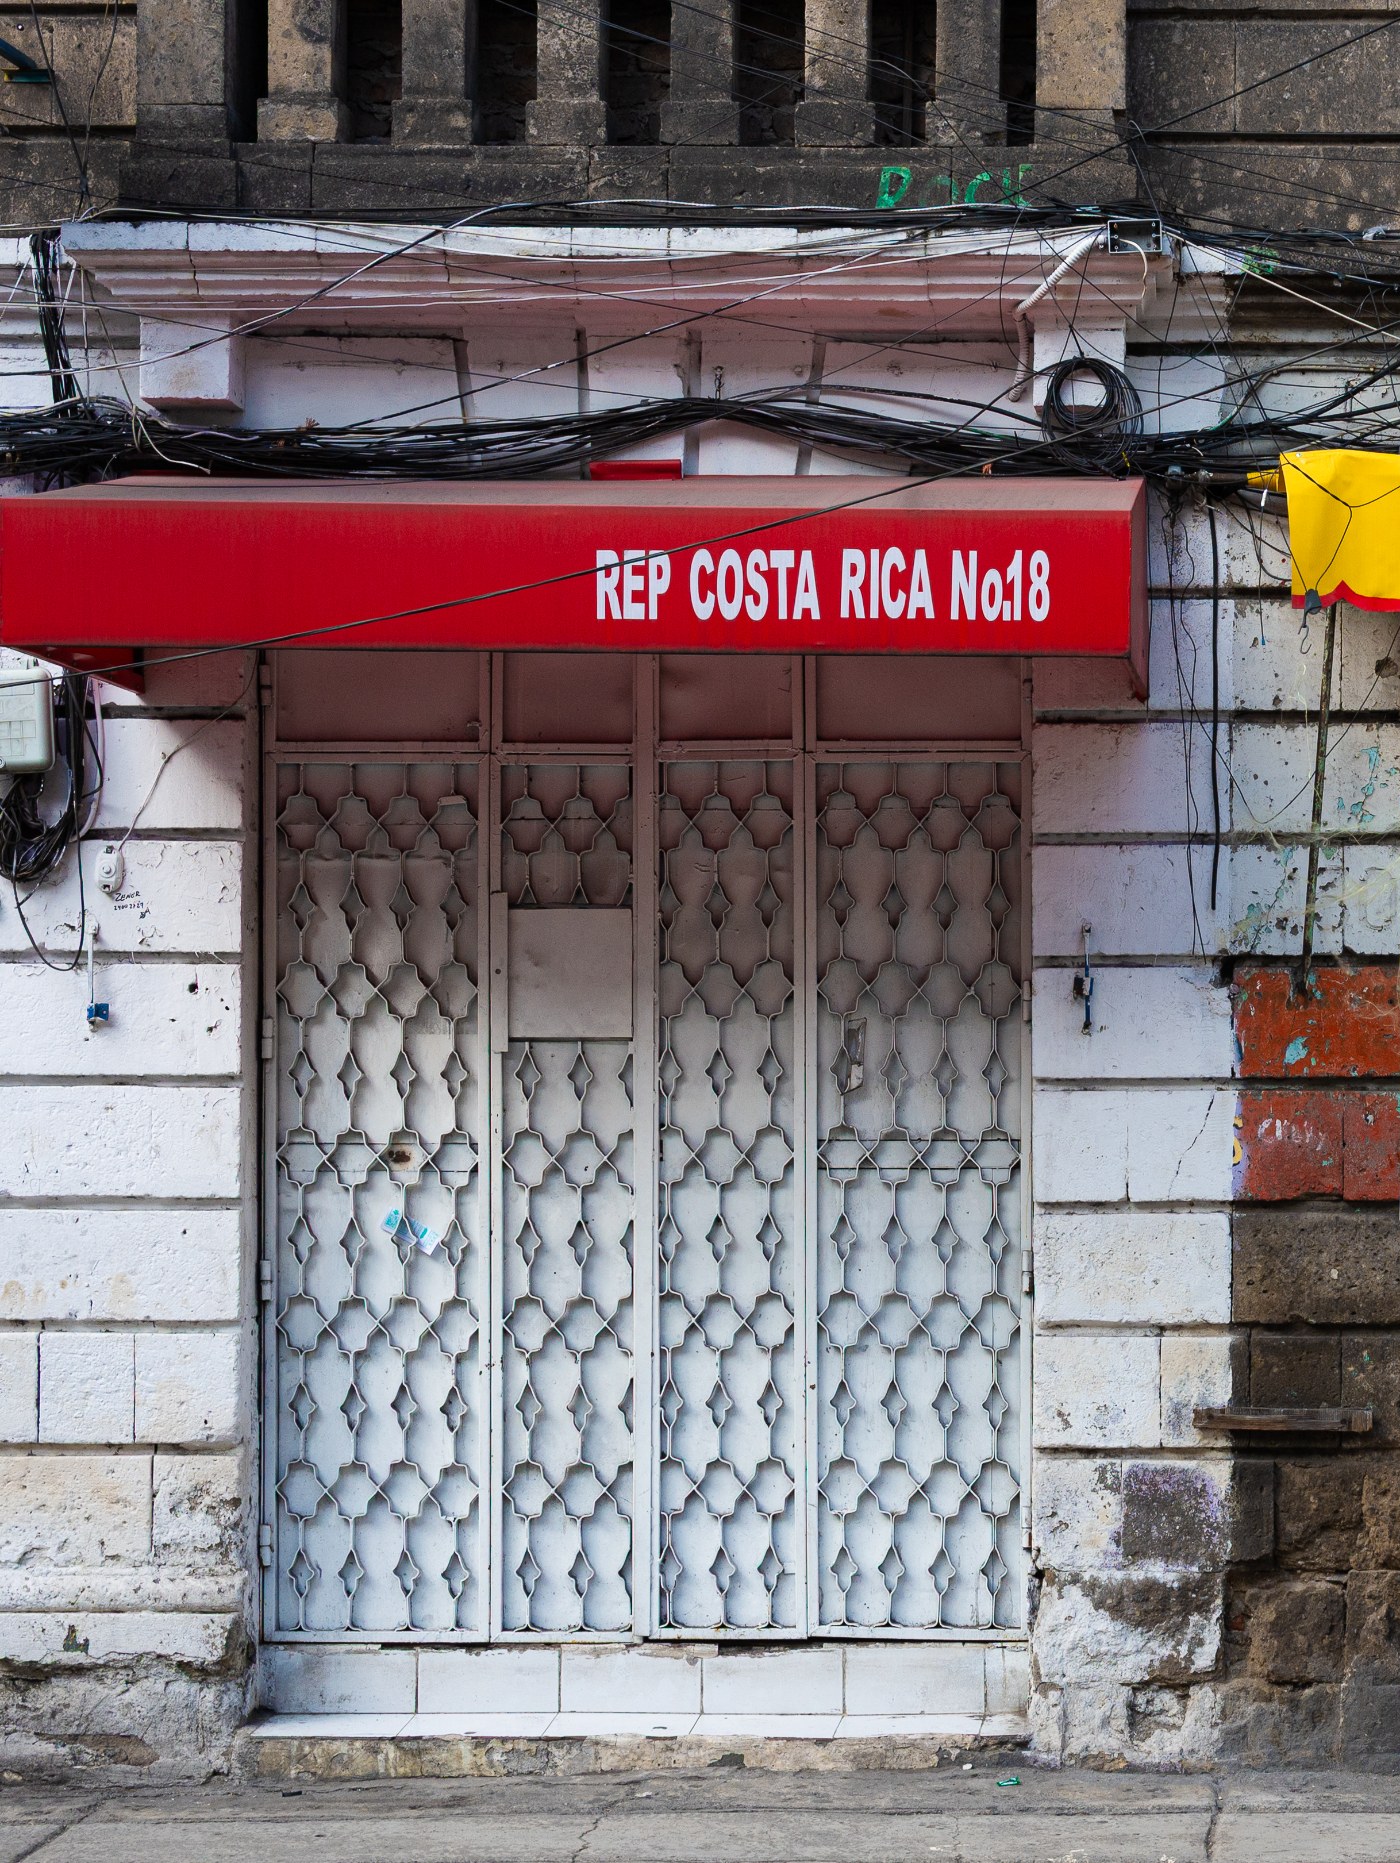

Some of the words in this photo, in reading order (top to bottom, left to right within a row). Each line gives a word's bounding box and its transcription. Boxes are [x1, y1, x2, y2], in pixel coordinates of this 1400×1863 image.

[596, 549, 671, 620] REP
[690, 548, 820, 621] COSTA
[840, 546, 935, 620] RICA
[951, 549, 1050, 622] No.18
